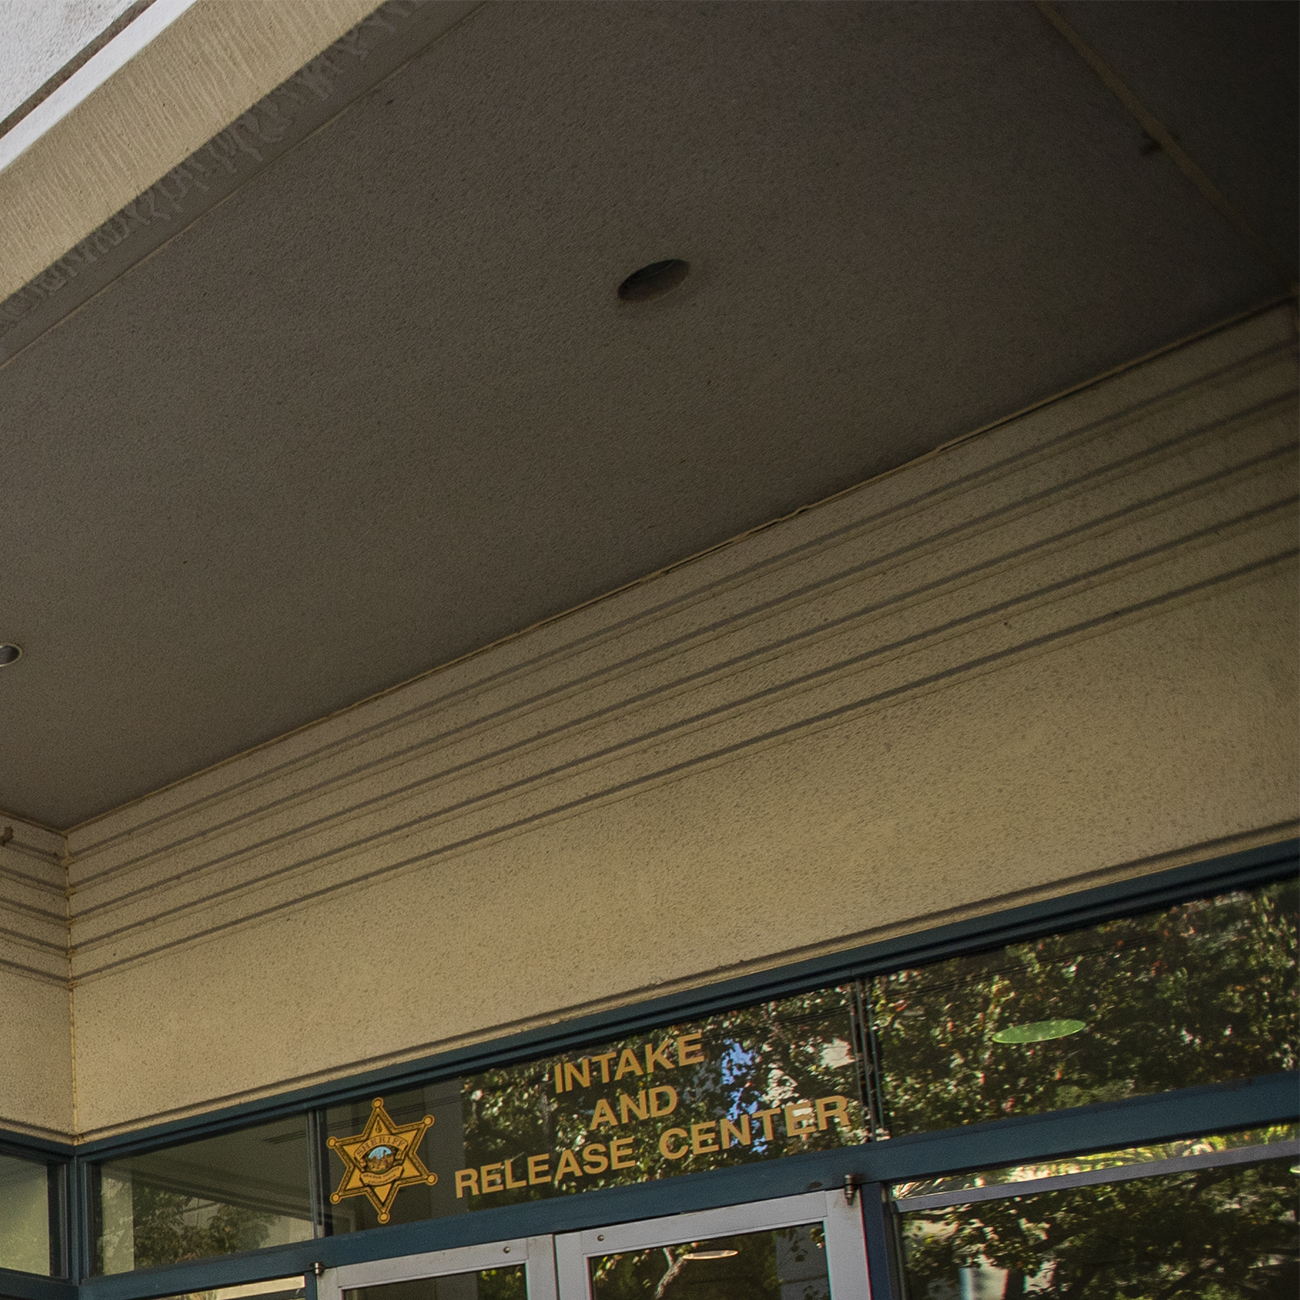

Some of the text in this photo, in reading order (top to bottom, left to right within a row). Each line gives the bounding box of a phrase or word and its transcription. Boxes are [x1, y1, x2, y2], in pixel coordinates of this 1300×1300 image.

[554, 1033, 704, 1093] INTAKE
[589, 1086, 678, 1130] AND
[357, 1136, 404, 1156] SHERIFF
[455, 1095, 851, 1198] RELEASE CENTER
